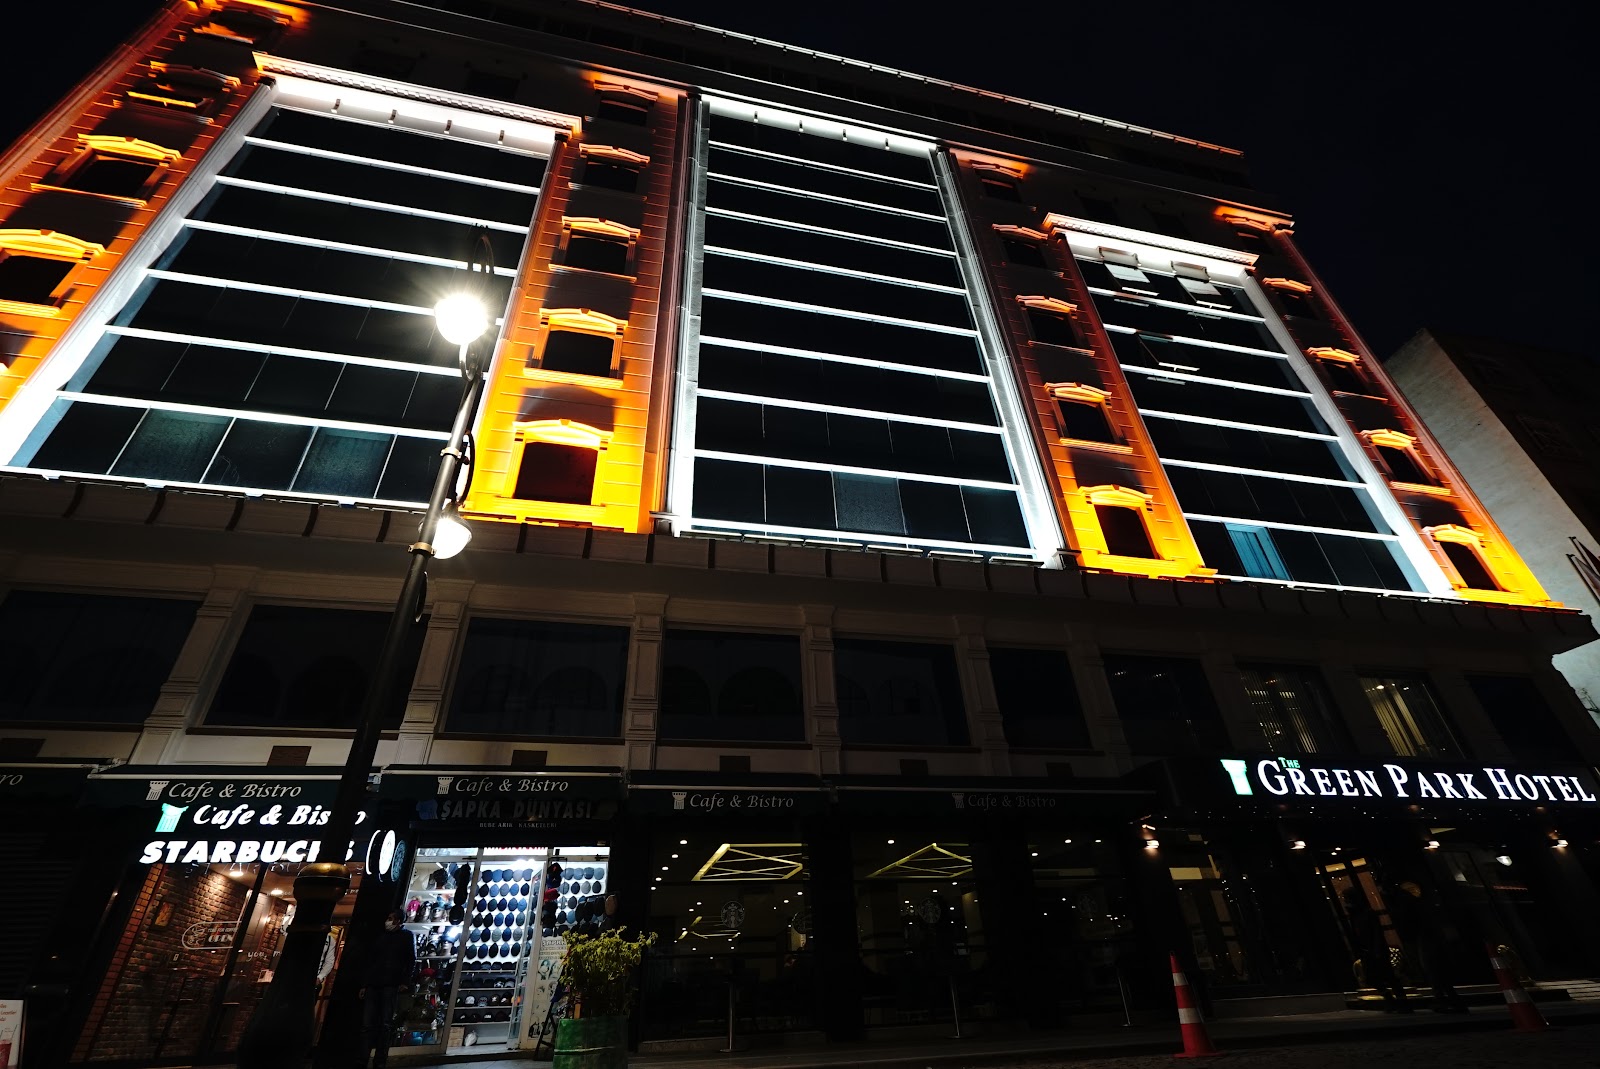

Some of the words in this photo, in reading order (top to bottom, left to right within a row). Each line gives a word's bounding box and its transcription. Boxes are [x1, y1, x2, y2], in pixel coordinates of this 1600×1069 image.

[1278, 757, 1301, 768] THE
[455, 777, 494, 796] Cafe
[499, 779, 512, 792] &
[517, 778, 569, 792] Bistro
[1257, 759, 1382, 798] GREEN
[1383, 764, 1487, 800] PARK
[1483, 768, 1597, 803] HOTEL
[168, 781, 214, 803] Cafe
[218, 783, 237, 798] &
[241, 783, 302, 798] Bistro
[967, 793, 997, 811] Cafe
[1001, 795, 1012, 807] &
[1015, 794, 1056, 807] Bistro
[441, 800, 501, 821] ŞAPKA
[689, 793, 725, 812] Cafe
[729, 794, 742, 808] &
[747, 794, 794, 808] Bistro
[193, 803, 255, 830] Cafe
[259, 804, 283, 826] &
[287, 804, 367, 826] Biso
